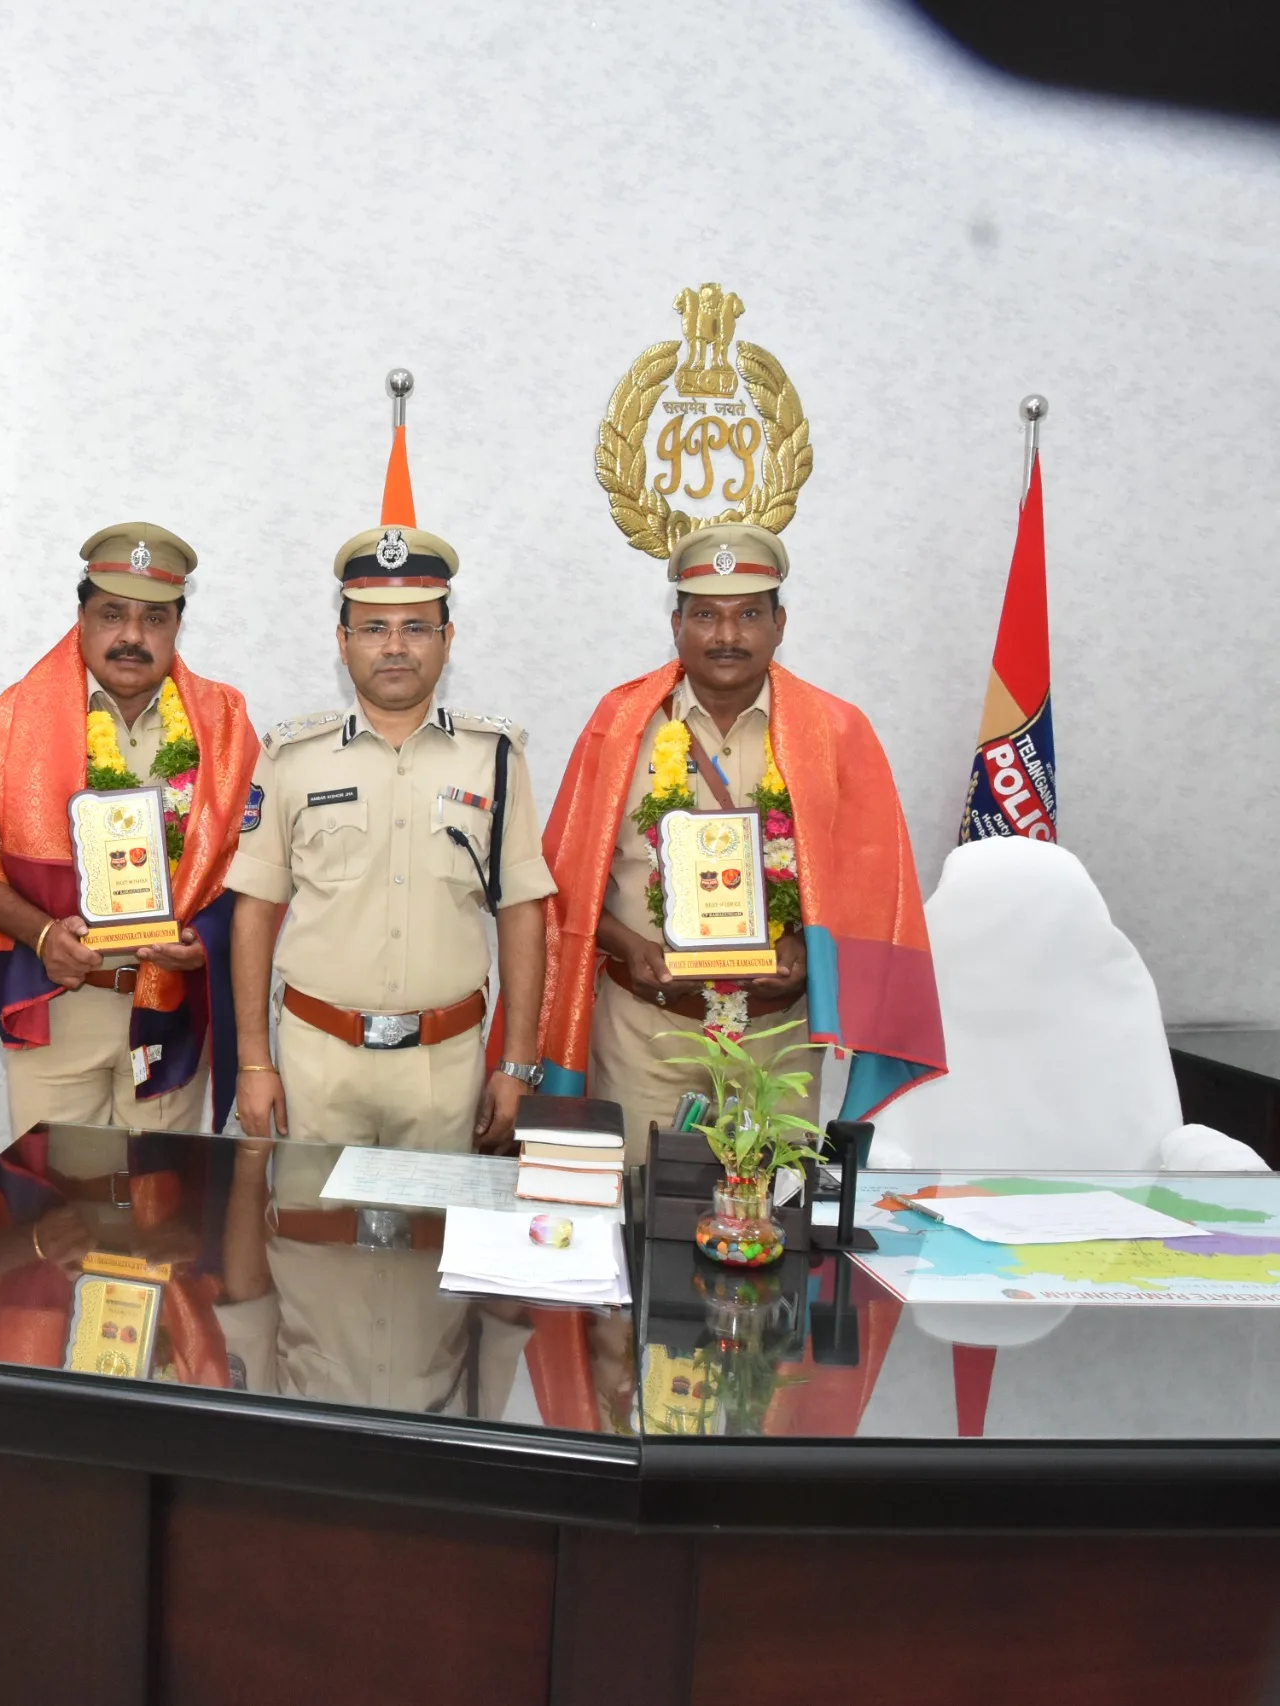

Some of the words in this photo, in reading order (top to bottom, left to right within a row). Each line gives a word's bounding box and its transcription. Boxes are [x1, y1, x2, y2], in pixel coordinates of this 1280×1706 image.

[662, 397, 707, 415] सत्यमेव
[714, 399, 747, 416] जयते
[653, 413, 762, 502] IPS
[1016, 733, 1055, 811] TELANGANA
[986, 743, 1056, 845] POLIC
[993, 812, 1012, 836] Duty
[99, 932, 143, 943] COMMISSIONERATE
[143, 929, 176, 939] RAMAGUNDAM
[687, 959, 736, 969] COMMISSIONERATE
[736, 958, 773, 967] RAMAGUNDAM
